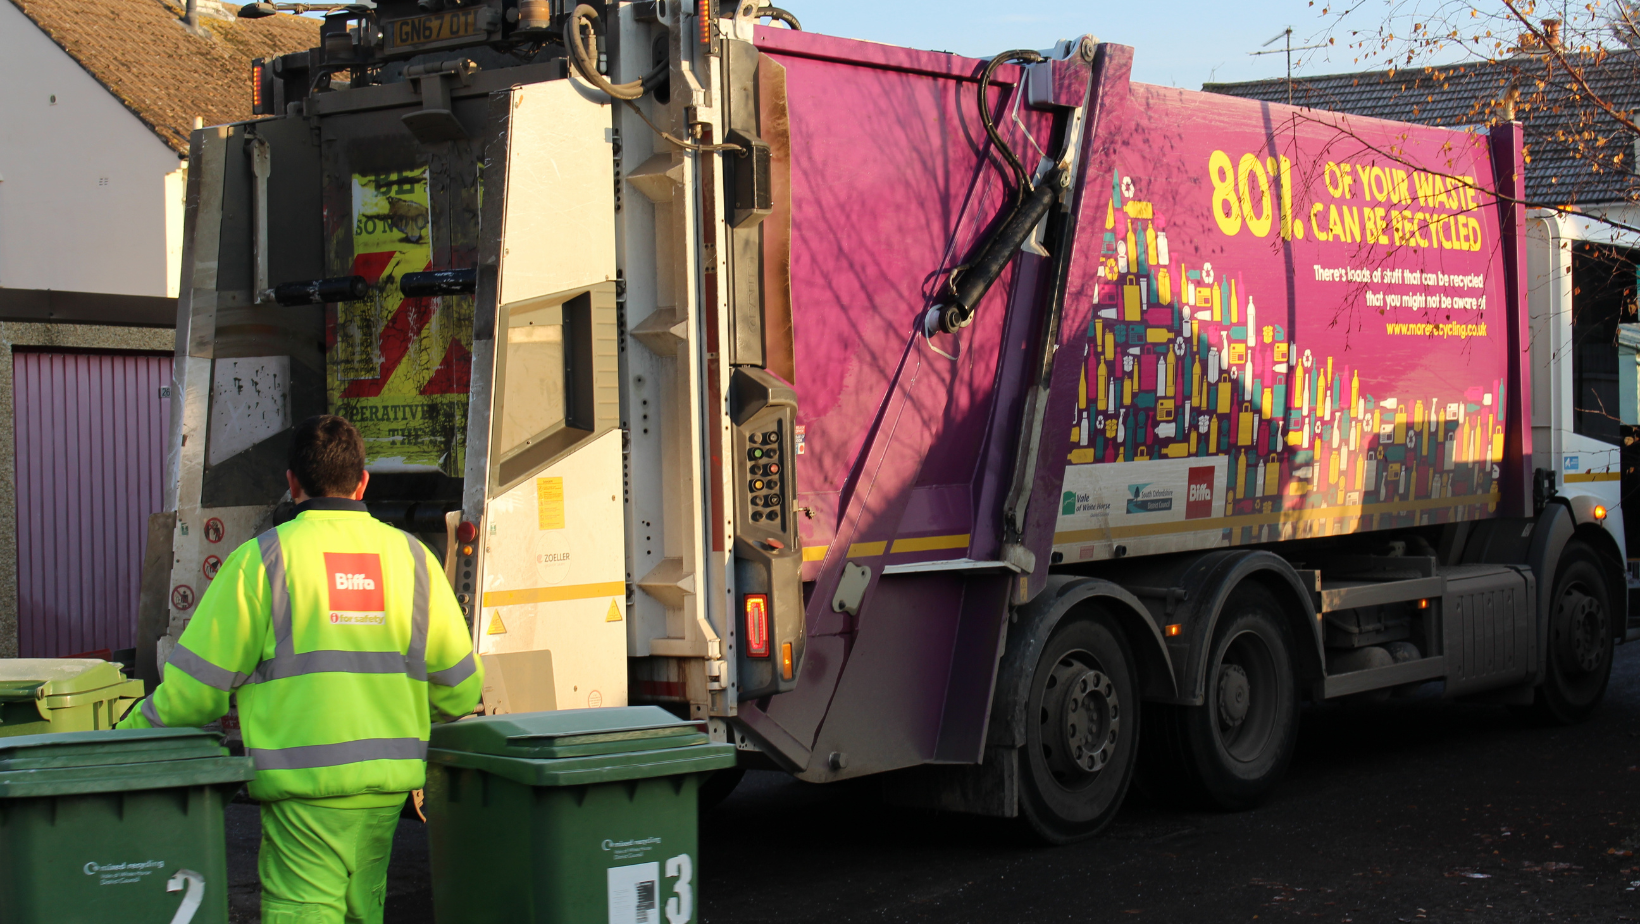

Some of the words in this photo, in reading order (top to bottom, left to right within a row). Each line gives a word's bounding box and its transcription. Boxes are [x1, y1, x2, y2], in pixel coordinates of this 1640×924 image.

[399, 15, 445, 43] GN67
[1324, 160, 1353, 200] OF
[1356, 164, 1412, 206] YOUR
[1412, 171, 1478, 212] WASTE
[1310, 202, 1361, 243] CAN
[1363, 206, 1389, 245] BE
[1391, 209, 1482, 252] RECYCLED
[1313, 264, 1347, 282] There's
[1347, 265, 1371, 283] loads
[1372, 267, 1382, 284] of
[1383, 268, 1402, 285] stuff
[1403, 269, 1421, 286] that
[1422, 272, 1437, 287] can
[1437, 270, 1449, 287] be
[1449, 272, 1484, 291] recycled
[1365, 290, 1384, 307] that
[1385, 293, 1401, 311] you
[1402, 292, 1426, 311] might
[1426, 293, 1440, 309] not
[1440, 292, 1452, 309] be
[1452, 296, 1477, 310] aware
[1478, 294, 1486, 310] of
[1076, 493, 1090, 503] Vale
[1189, 483, 1211, 502] Biffa
[544, 552, 570, 563] ZOELLER
[335, 573, 375, 590] Biffa
[340, 614, 353, 623] for
[354, 614, 384, 624] safety
[665, 853, 693, 924] 3
